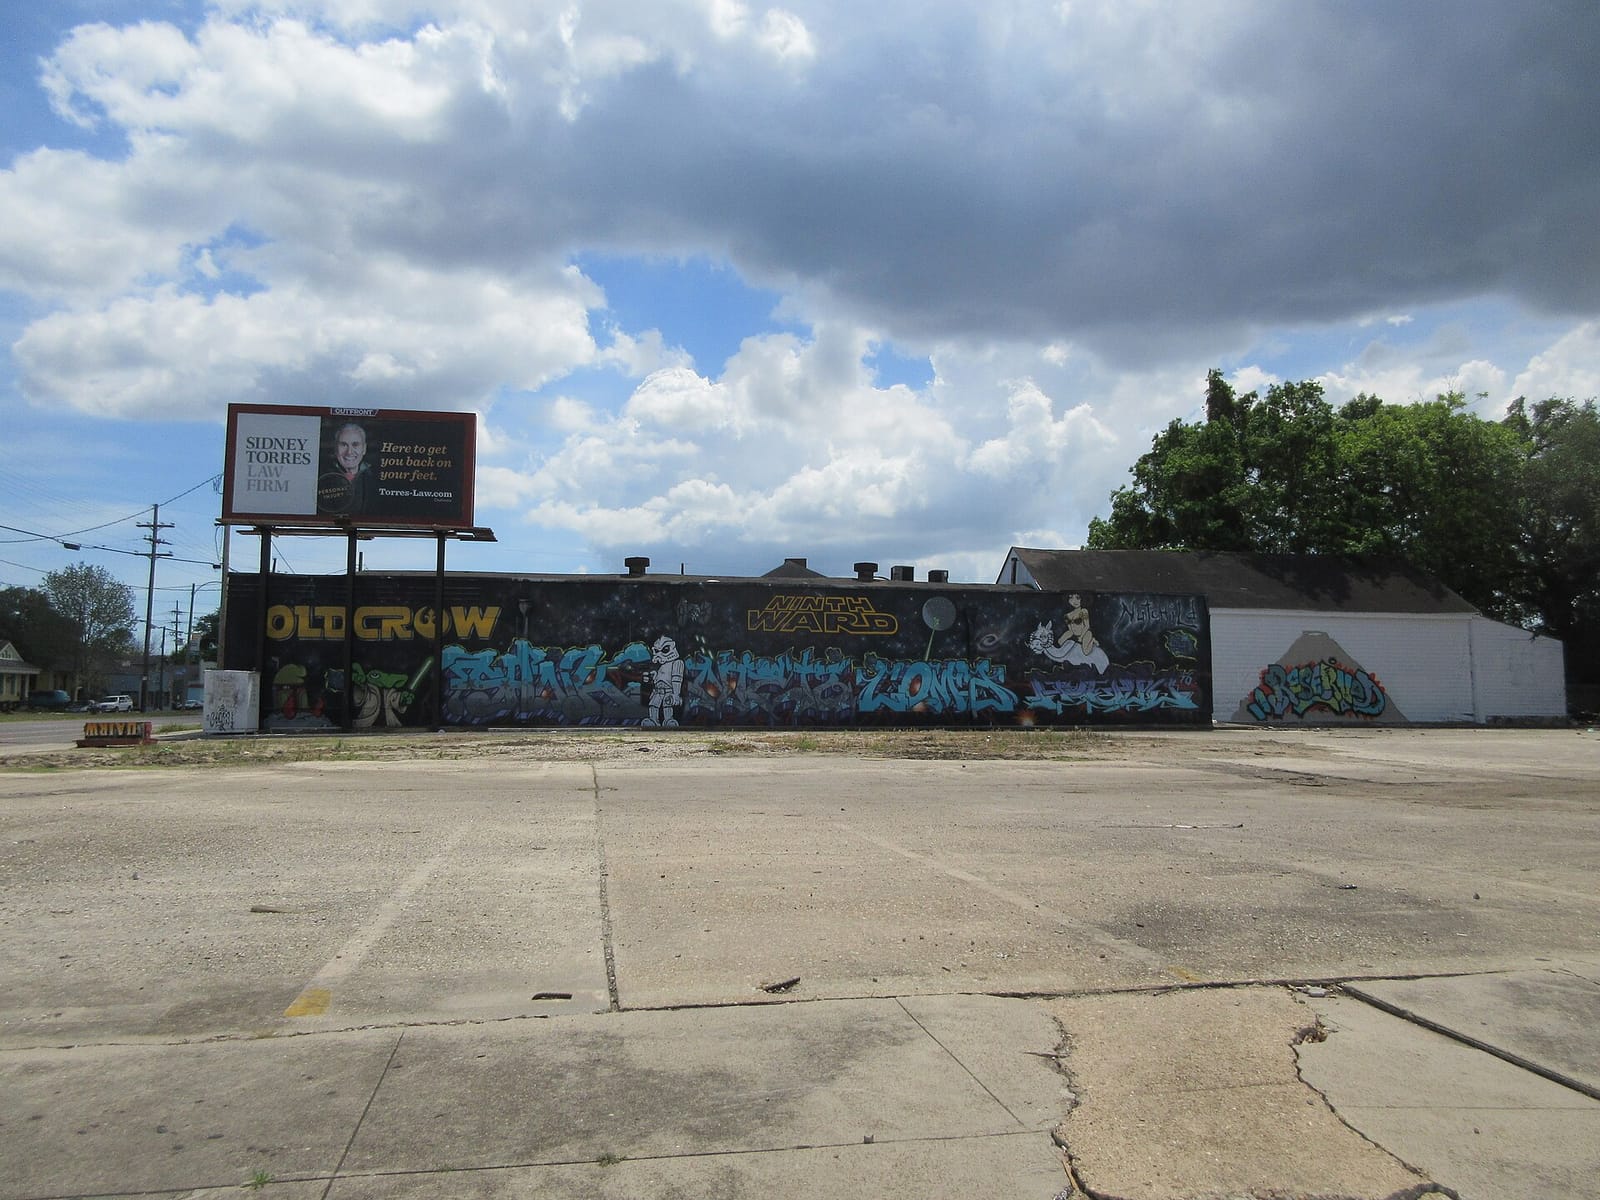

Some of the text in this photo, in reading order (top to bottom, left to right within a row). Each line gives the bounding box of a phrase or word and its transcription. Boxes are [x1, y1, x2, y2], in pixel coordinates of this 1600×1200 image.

[335, 408, 374, 416] OUTFRONT
[246, 436, 308, 451] SIDNEY
[380, 442, 448, 456] Here to get
[245, 450, 311, 465] TORRES
[380, 456, 452, 468] you back on
[247, 465, 285, 478] LAW
[380, 470, 438, 482] your feet.
[246, 479, 291, 493] FIRM
[379, 487, 453, 498] Torres-Law.com
[765, 595, 876, 612] NINTH
[266, 604, 346, 640] OLD
[747, 610, 899, 635] WARD
